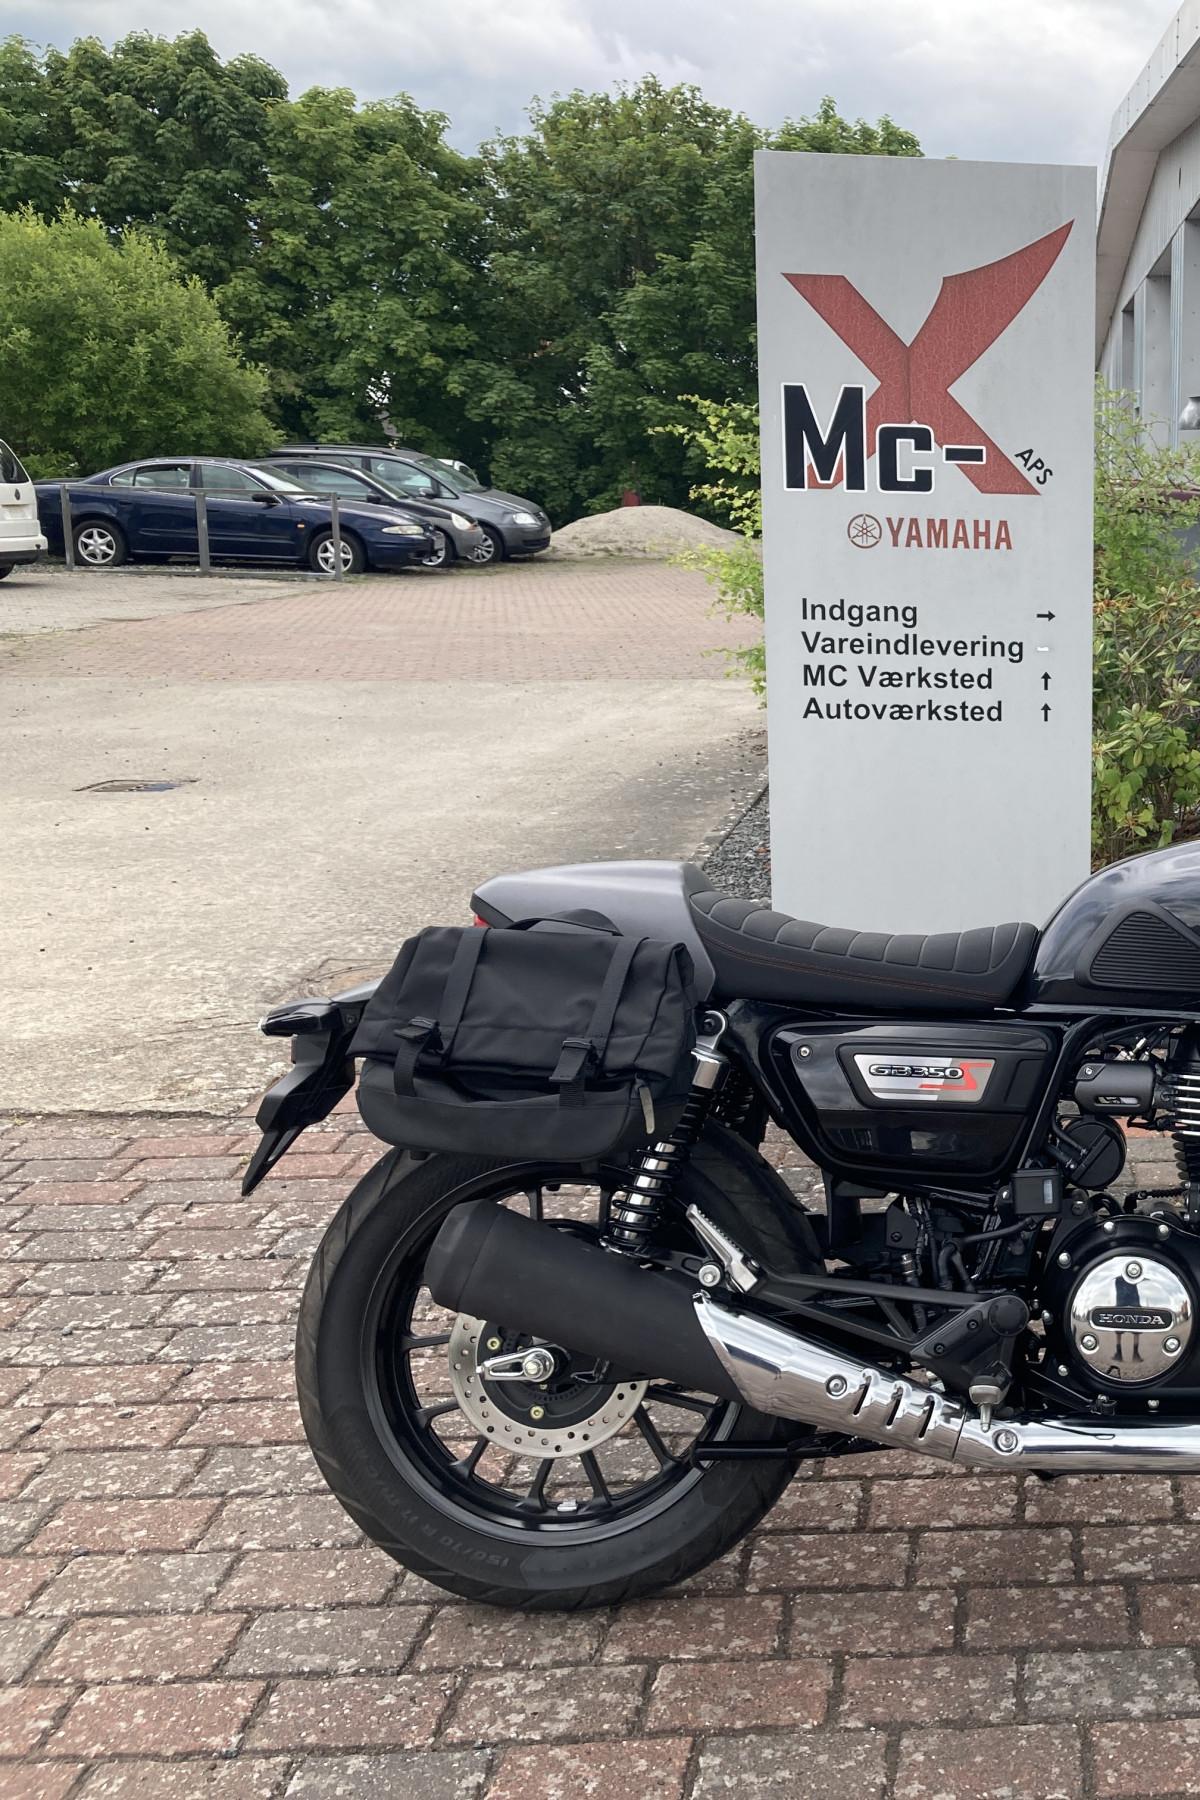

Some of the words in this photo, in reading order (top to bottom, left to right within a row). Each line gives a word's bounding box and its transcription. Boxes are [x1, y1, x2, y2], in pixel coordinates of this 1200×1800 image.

[1014, 448, 1053, 485] APS
[886, 517, 1012, 550] YAMAHA
[802, 598, 917, 628] Indgang
[801, 631, 1023, 663] Vareindlevering
[803, 664, 847, 687] MC
[858, 665, 992, 689] Værksted
[802, 697, 1002, 721] Autoværksted
[1098, 1313, 1165, 1325] HONDA
